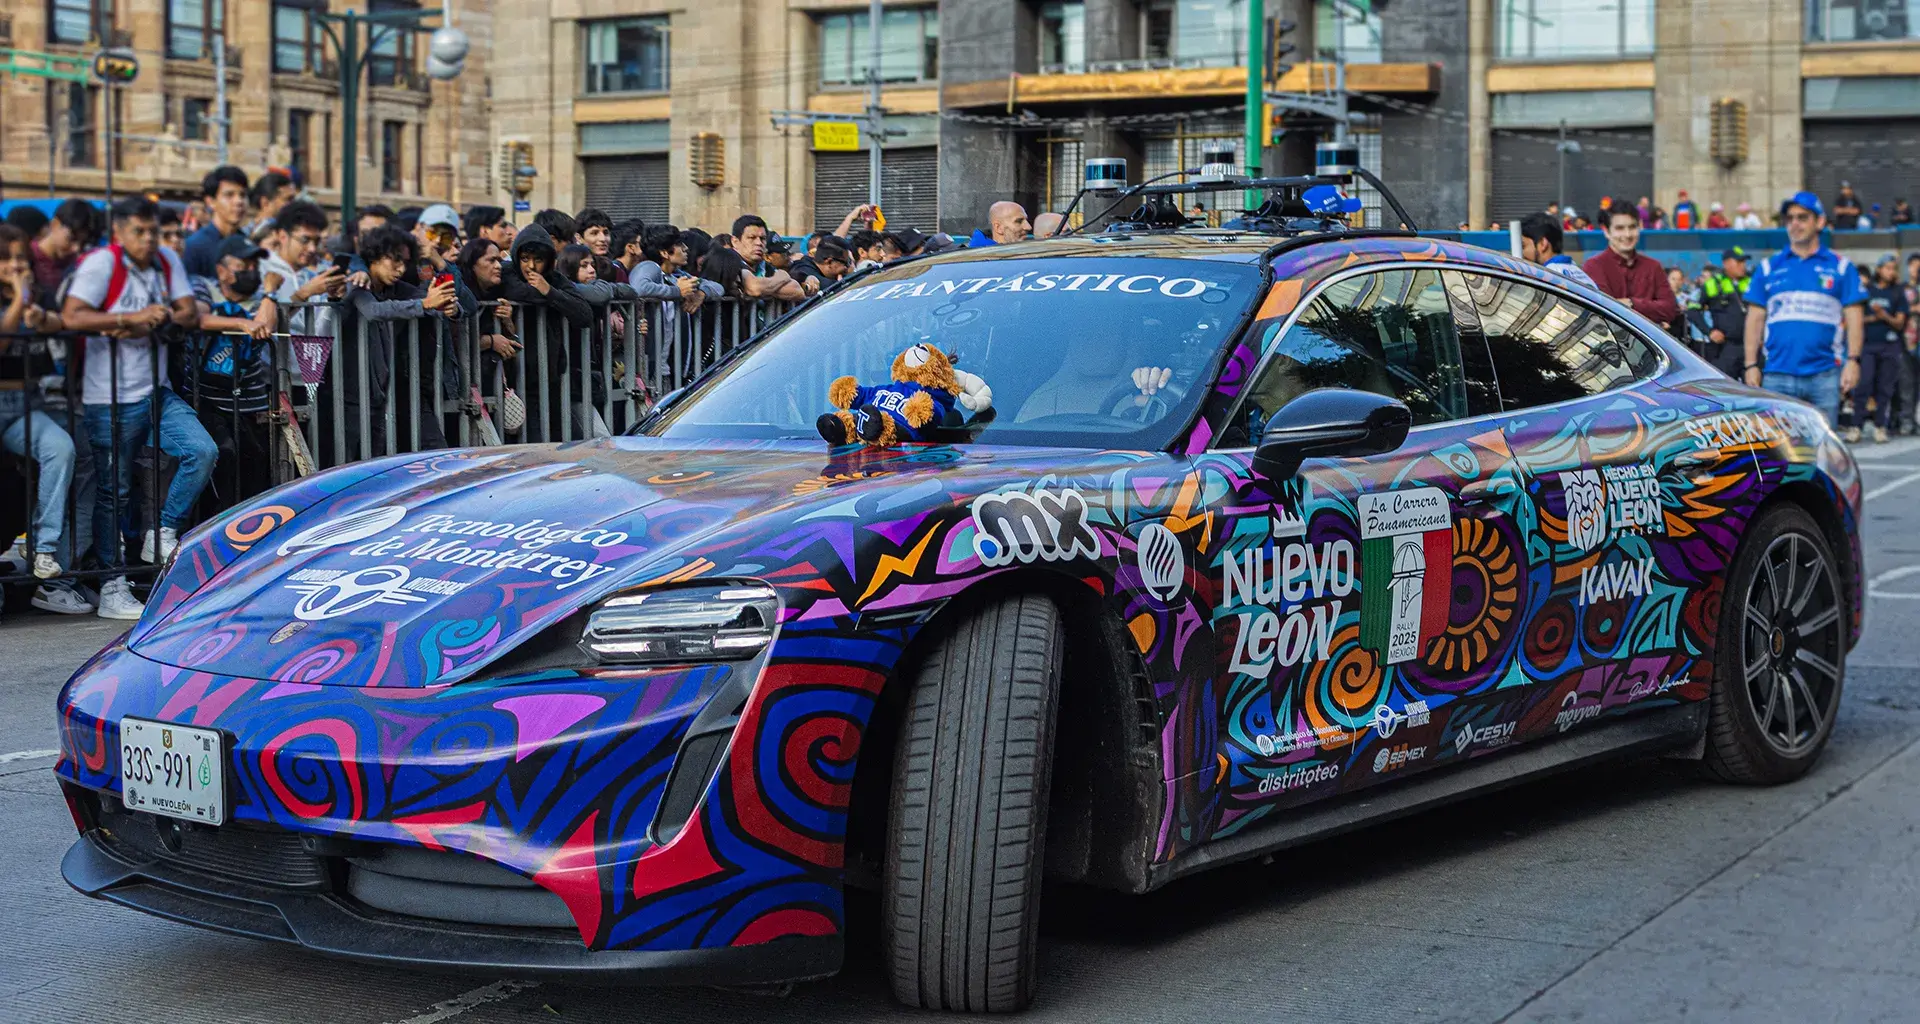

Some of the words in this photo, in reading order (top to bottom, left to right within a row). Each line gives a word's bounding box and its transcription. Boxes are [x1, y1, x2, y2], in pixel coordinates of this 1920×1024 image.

[874, 271, 1207, 300] FANTÁSTICO
[1684, 412, 1780, 449] SEKURA
[1602, 465, 1639, 481] HECHO
[1640, 464, 1657, 478] EN
[1607, 478, 1661, 501] NUEVO
[1368, 497, 1387, 514] La
[1393, 494, 1438, 514] Carrera
[401, 513, 629, 549] Tecnológico
[1367, 514, 1447, 535] Panamericana
[350, 535, 405, 557] de
[394, 537, 616, 591] Monterrey
[1579, 556, 1655, 606] KAVAK
[1396, 621, 1415, 631] RALLY
[1392, 631, 1417, 647] 2025
[1555, 704, 1601, 729] movyon
[1472, 721, 1516, 743] CESVI
[1389, 746, 1427, 764] SEMEX
[123, 744, 193, 791] 33S-991
